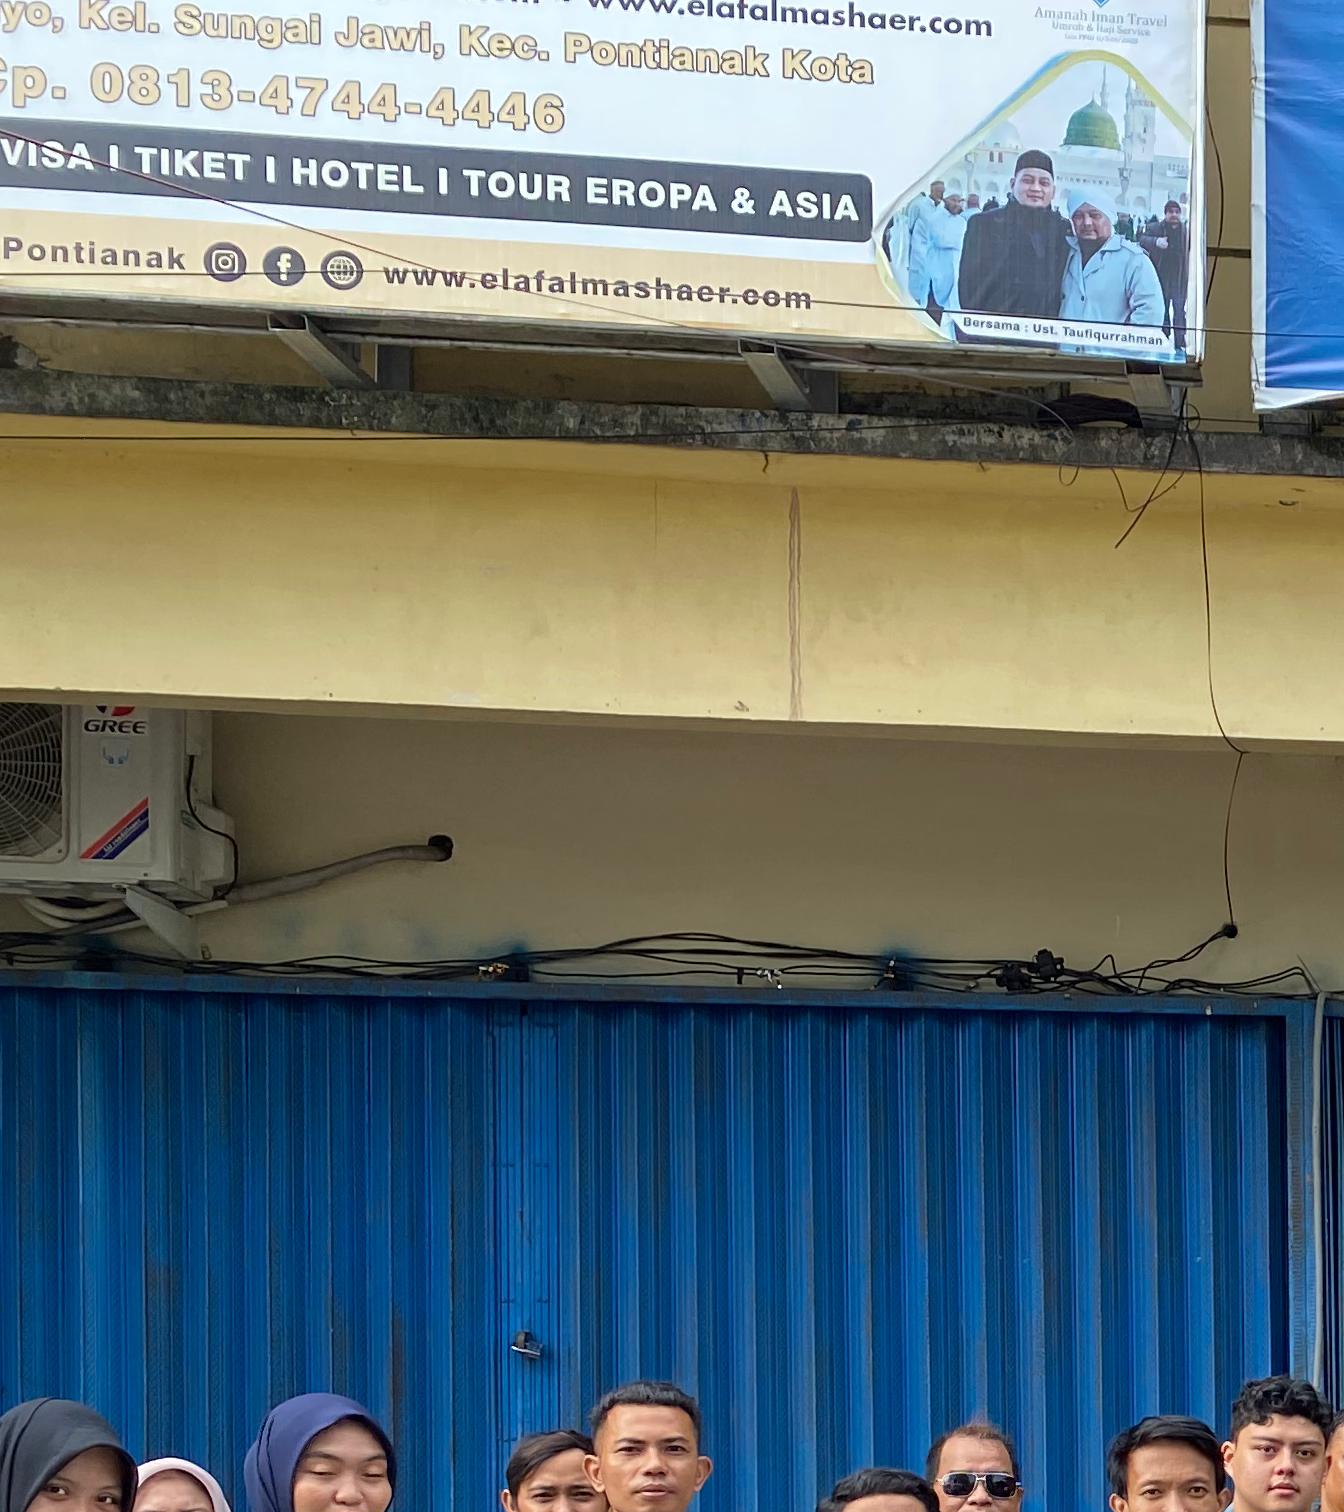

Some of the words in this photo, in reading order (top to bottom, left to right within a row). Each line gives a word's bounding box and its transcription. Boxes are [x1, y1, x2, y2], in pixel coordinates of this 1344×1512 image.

[79, 0, 160, 33] Kel.
[174, 3, 321, 49] Sungai
[334, 16, 444, 60] Jawi,
[458, 24, 550, 61] Kec.
[564, 31, 770, 78] Pontianak
[782, 48, 875, 84] Kota
[1034, 6, 1088, 22] Amanah
[1091, 11, 1125, 25] Iman
[1127, 12, 1168, 28] Travel
[0, 57, 67, 109] p.
[90, 61, 566, 134] 0813-4744-4446
[0, 138, 96, 171] VISA
[134, 146, 251, 181] TIKET
[292, 156, 425, 194] HOTEL
[462, 168, 571, 202] TOUR
[586, 176, 718, 212] EROPA
[730, 186, 756, 215] &
[768, 189, 860, 222] ASIA
[3, 236, 186, 271] Pontianak
[383, 266, 812, 310] www.elafalmashaer.com
[963, 316, 1021, 332] Bersama
[1063, 326, 1163, 347] Taufiqurrahman
[84, 719, 148, 735] GREE
